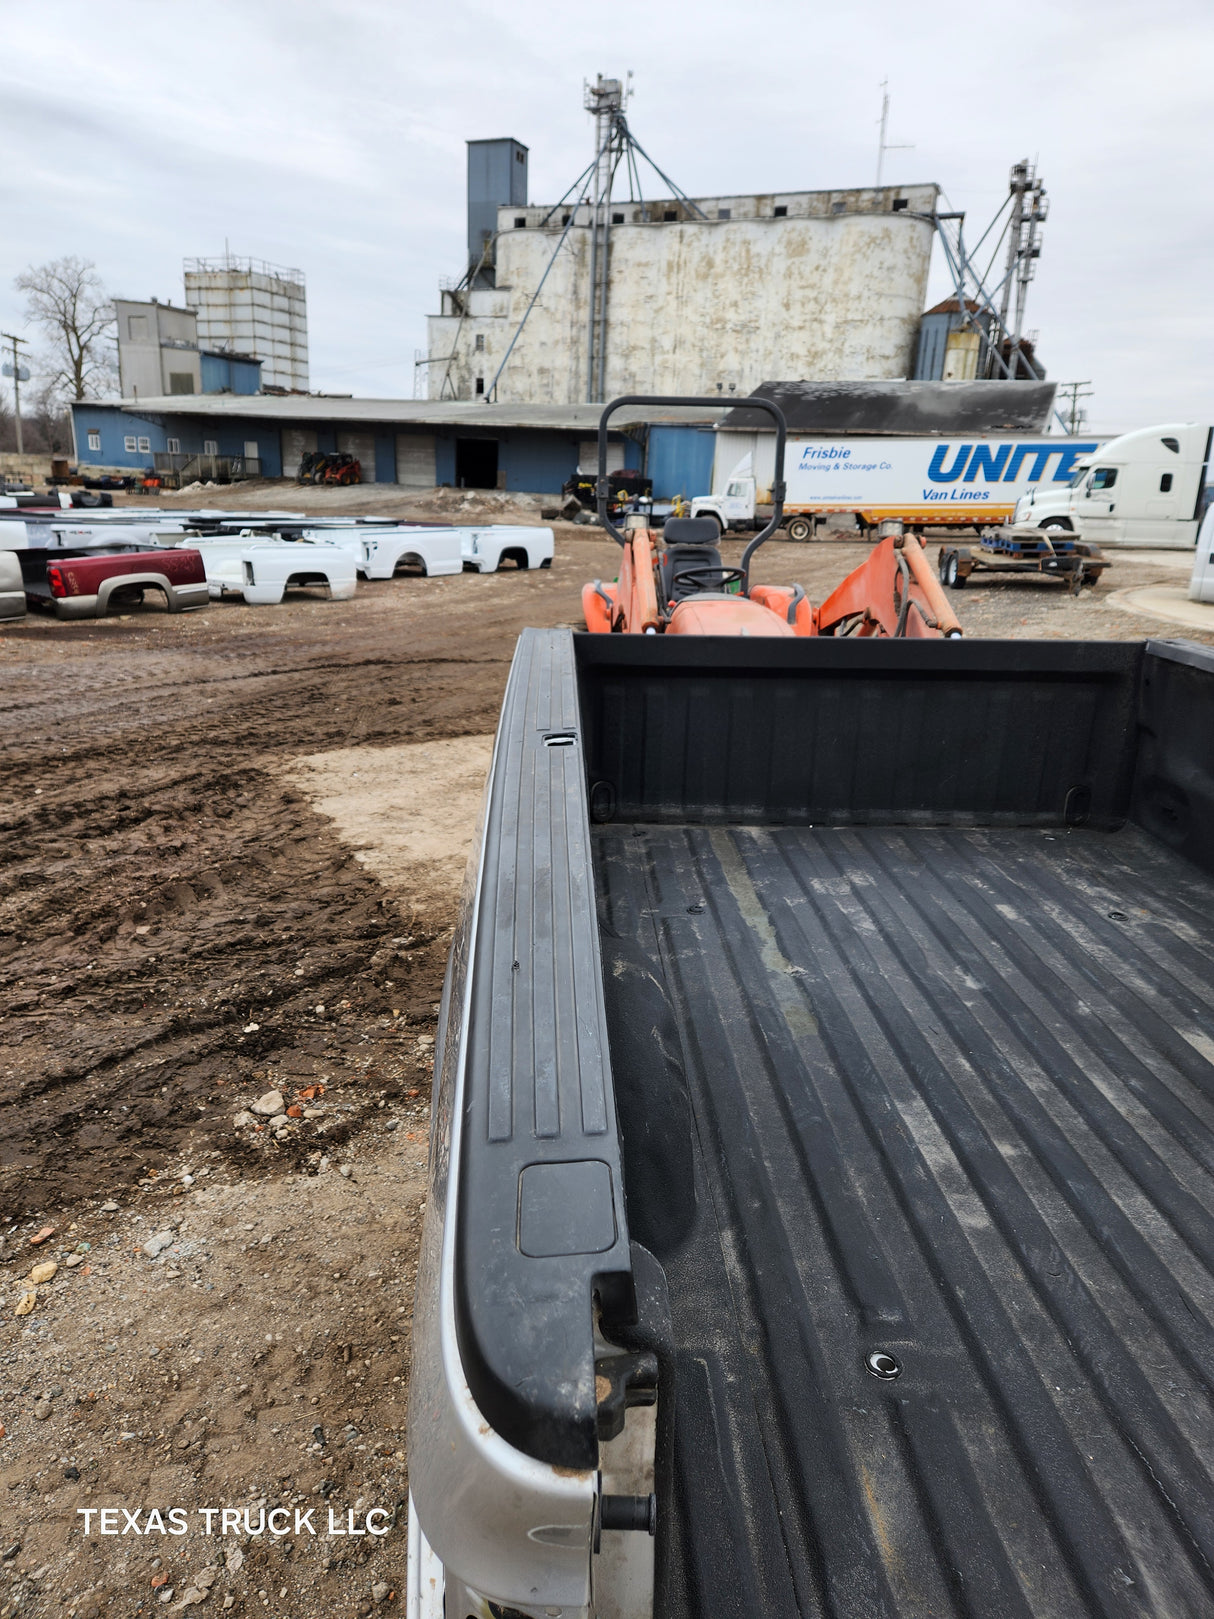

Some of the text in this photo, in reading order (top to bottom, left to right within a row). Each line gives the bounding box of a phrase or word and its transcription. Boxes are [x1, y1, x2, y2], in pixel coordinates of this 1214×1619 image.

[802, 446, 851, 459] Frisbie
[798, 461, 894, 473] Moving & Storage Co.
[922, 487, 990, 501] Van Lines
